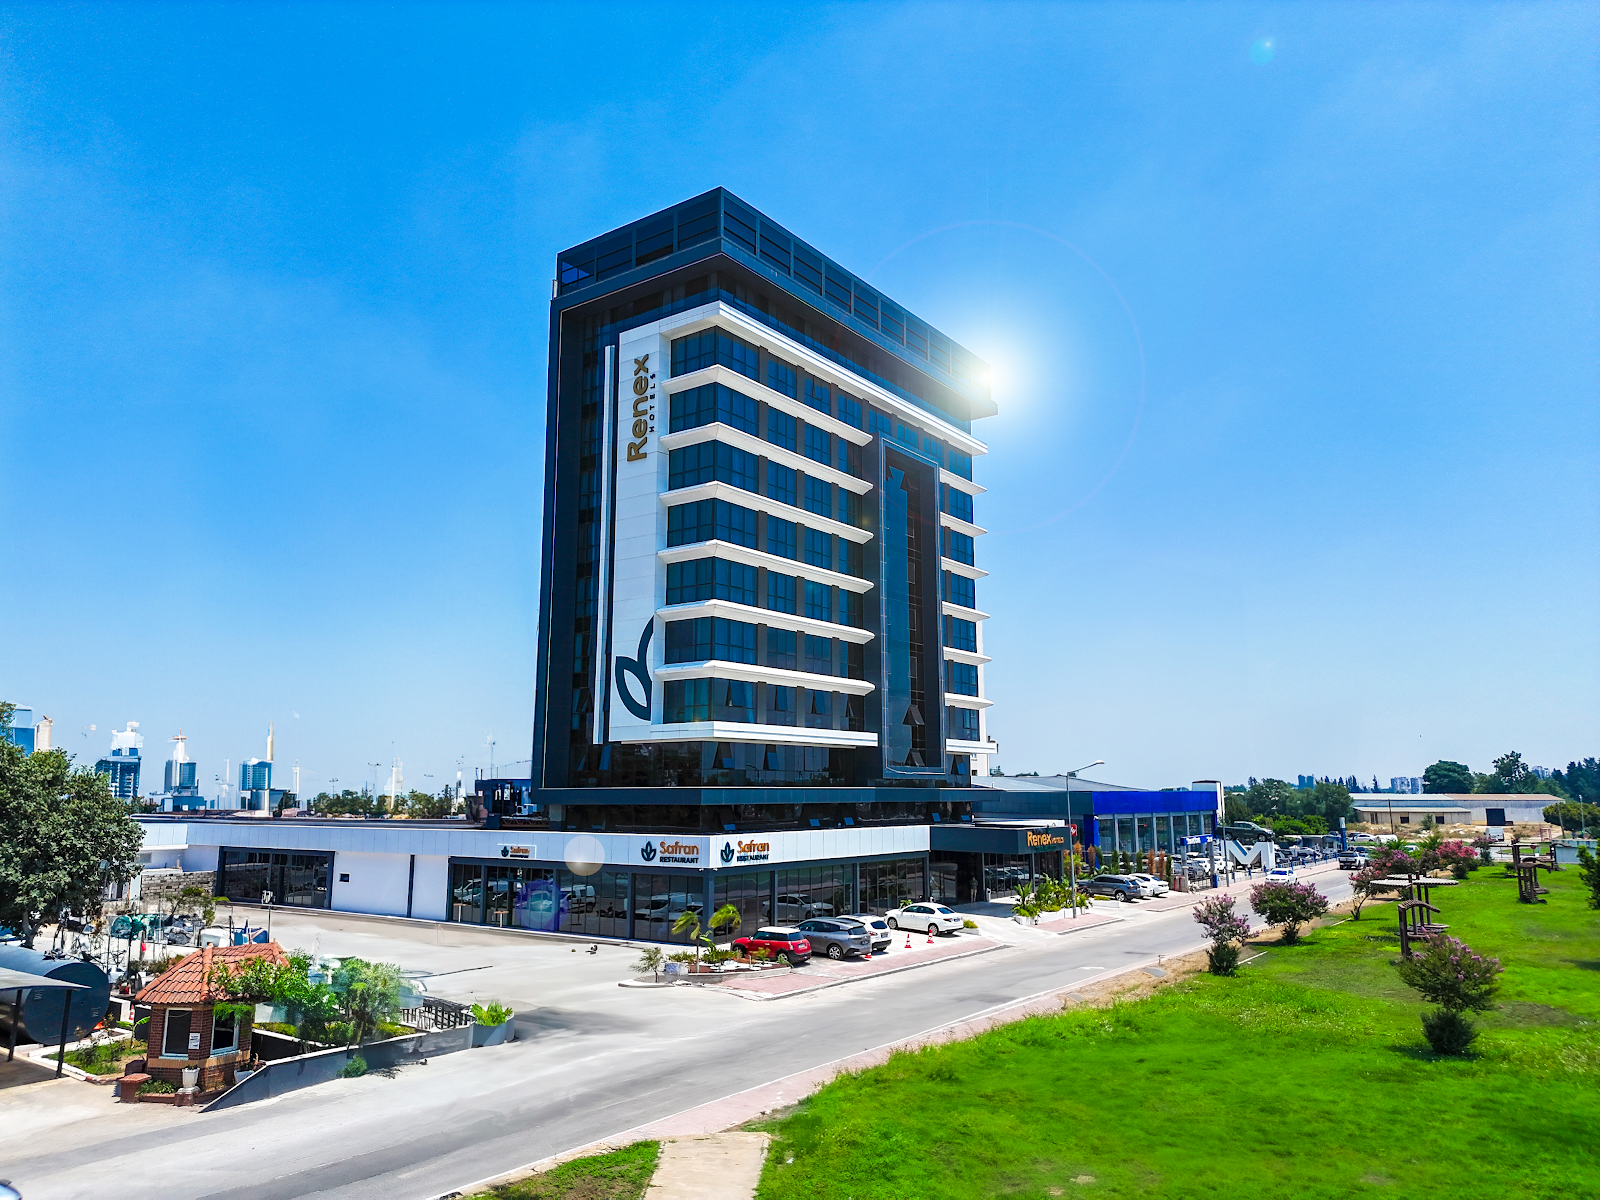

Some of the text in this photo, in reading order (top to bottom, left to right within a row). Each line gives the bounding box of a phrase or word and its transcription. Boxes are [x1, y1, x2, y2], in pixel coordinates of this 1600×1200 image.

[627, 354, 649, 462] Renex
[1027, 831, 1052, 847] Renex
[660, 841, 699, 855] Safran
[737, 840, 770, 854] Safran
[660, 856, 699, 864] RESTAURANT
